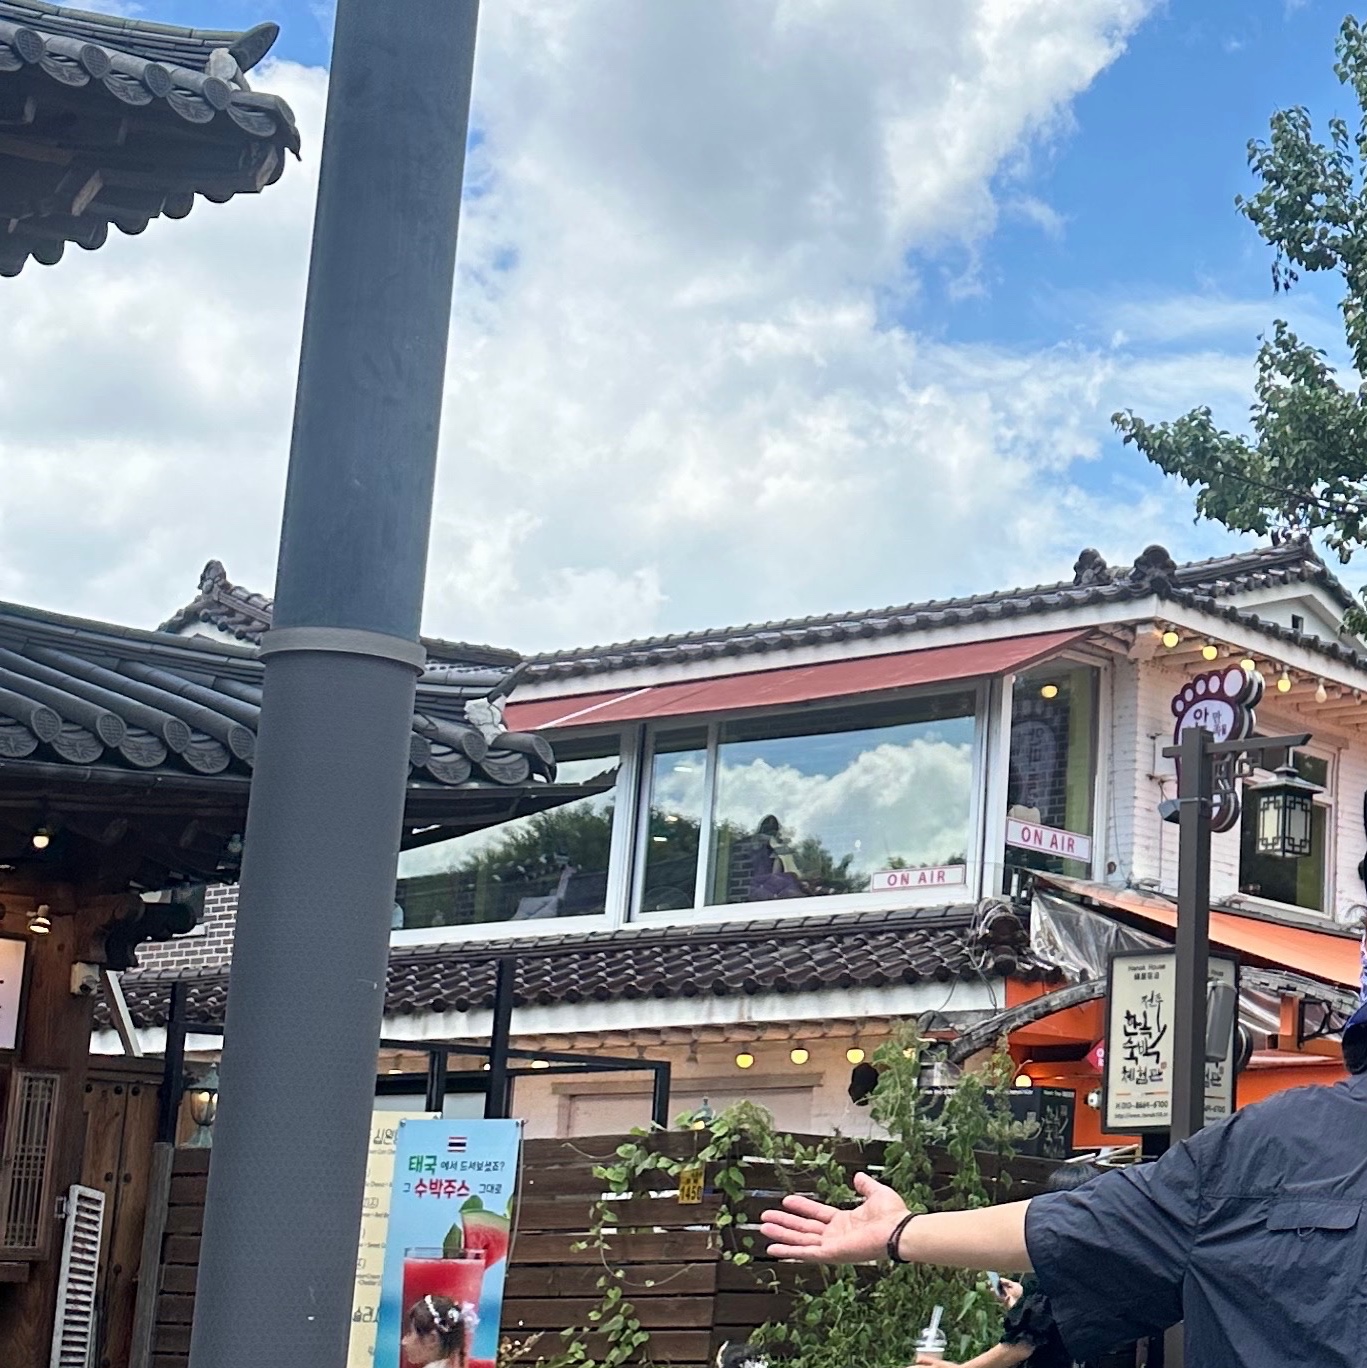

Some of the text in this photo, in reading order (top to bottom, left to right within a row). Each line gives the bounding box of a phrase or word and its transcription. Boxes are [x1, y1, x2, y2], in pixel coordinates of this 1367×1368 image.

[1021, 826, 1075, 853] ON AIR
[887, 870, 946, 886] ON AIR
[408, 1155, 437, 1175] 태국
[440, 1161, 458, 1171] 에서
[402, 1182, 411, 1193] 그
[414, 1178, 470, 1199] 수박주스
[478, 1183, 502, 1194] 그대로
